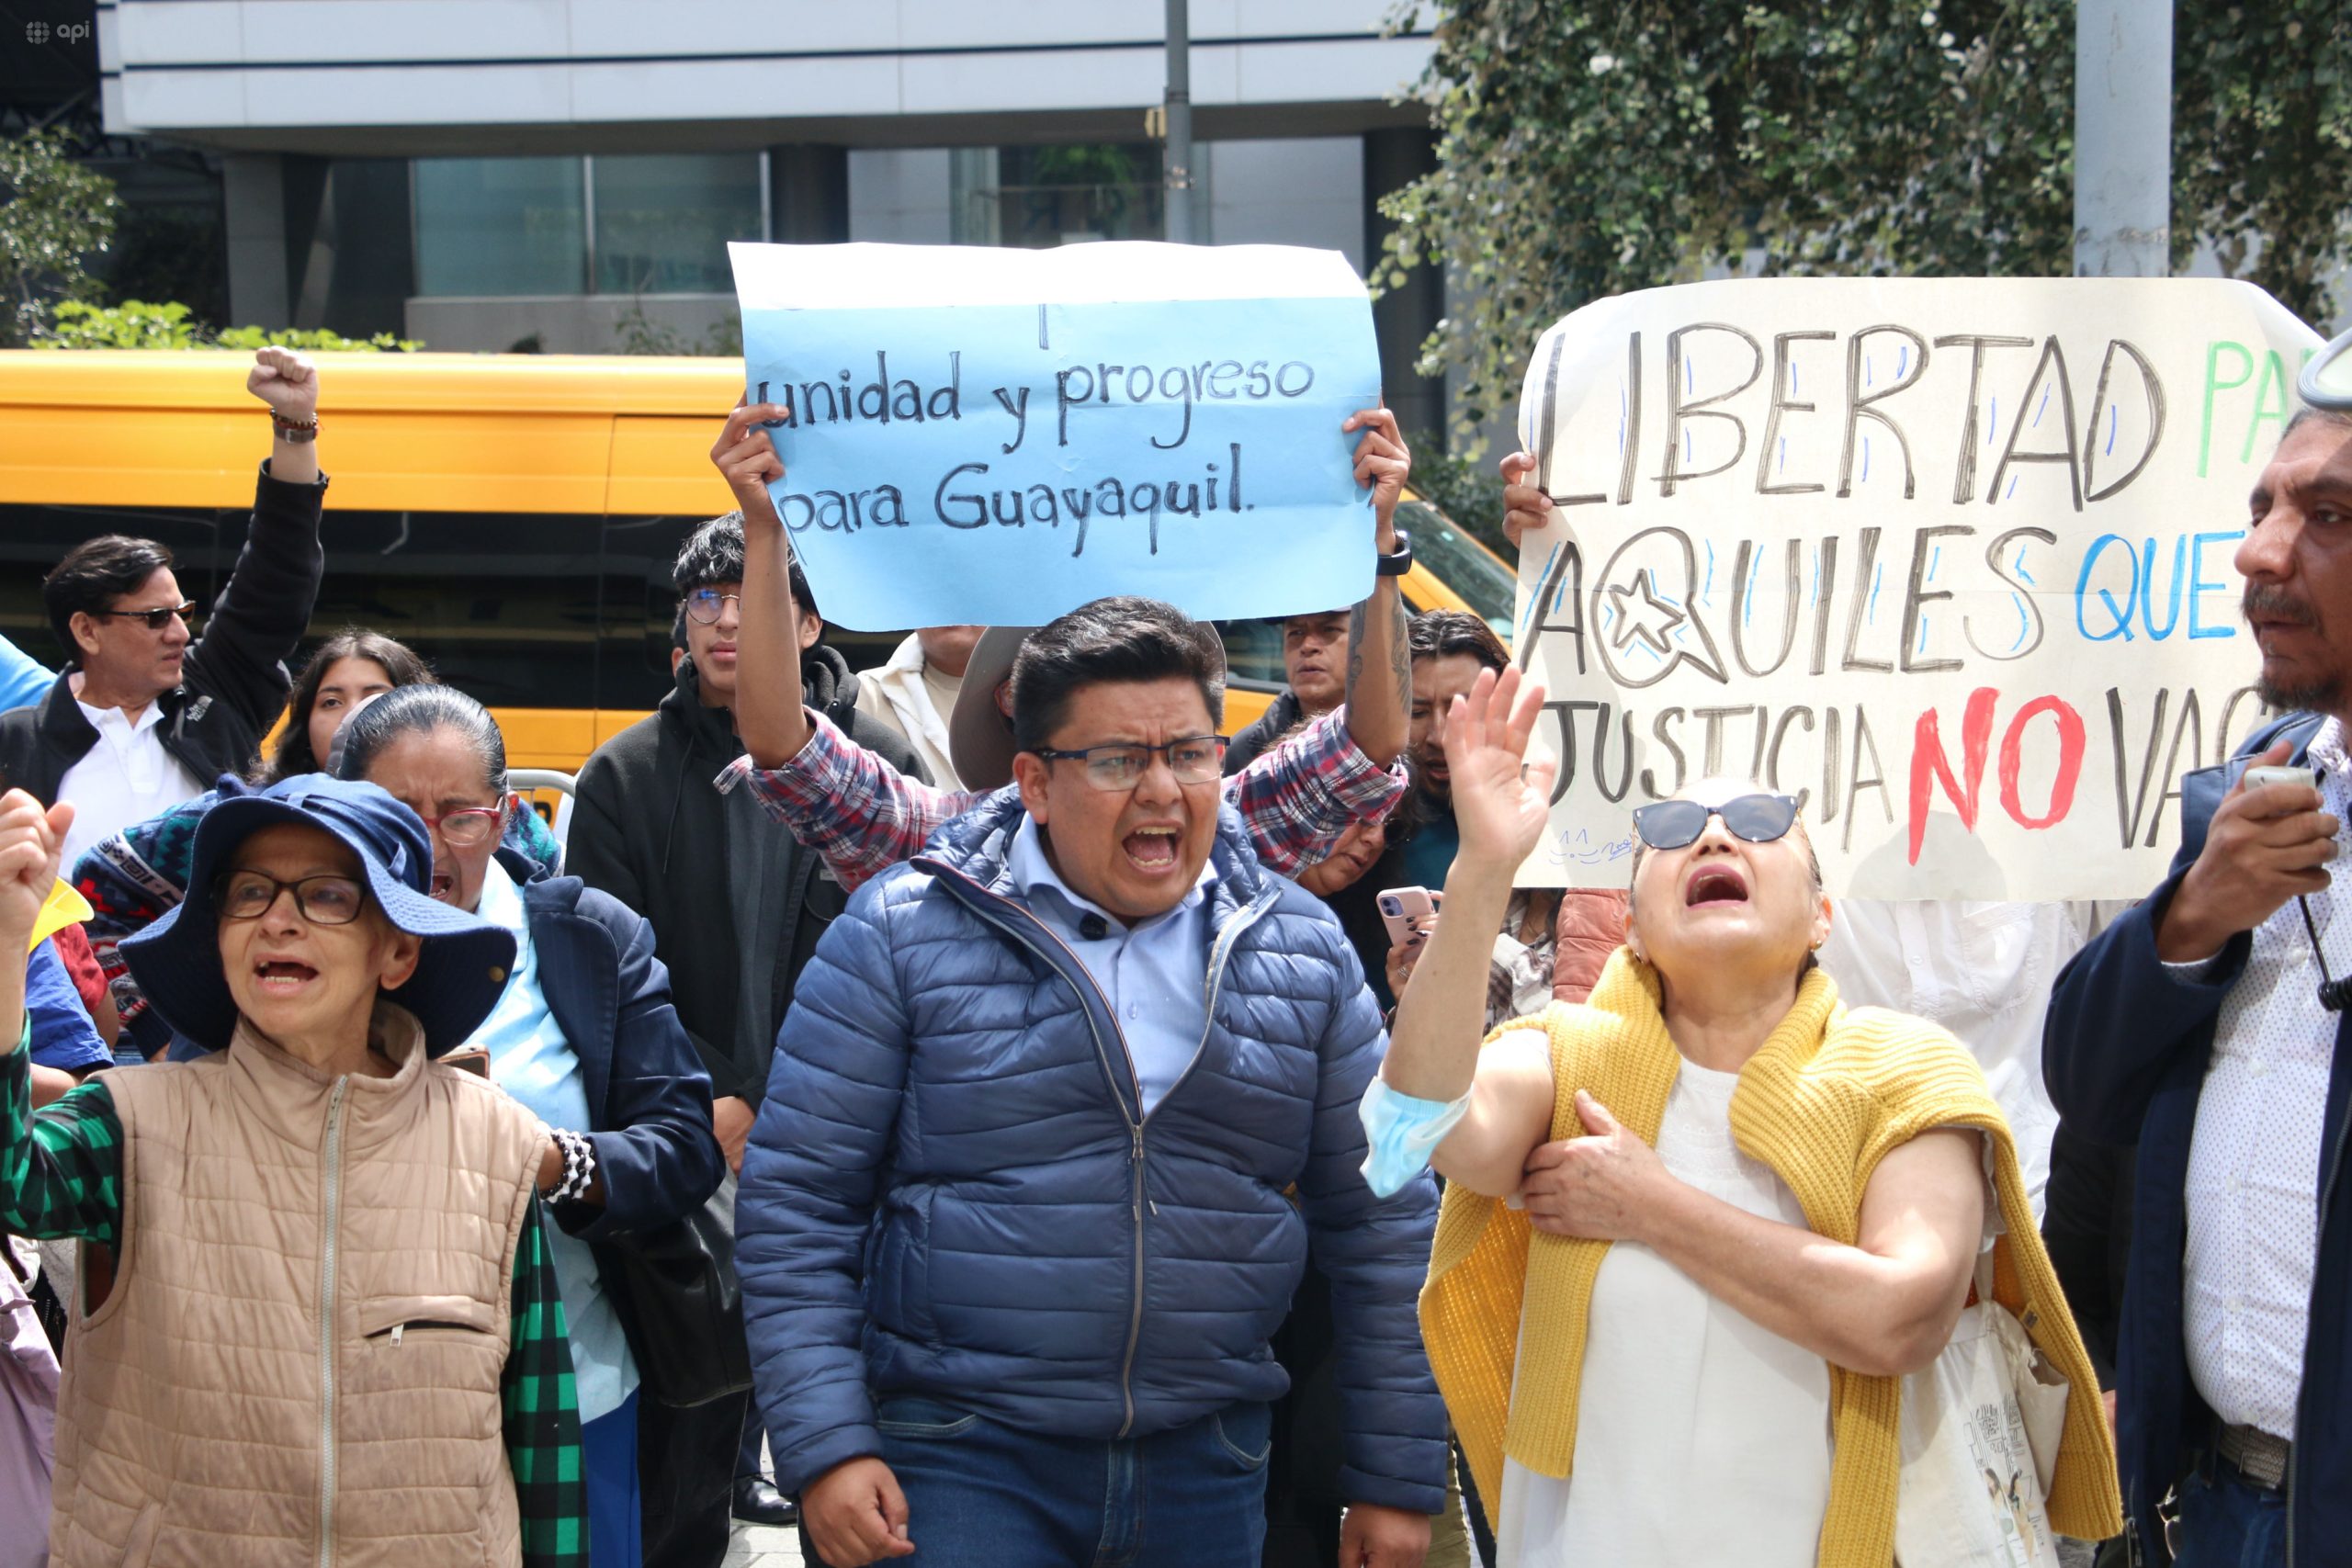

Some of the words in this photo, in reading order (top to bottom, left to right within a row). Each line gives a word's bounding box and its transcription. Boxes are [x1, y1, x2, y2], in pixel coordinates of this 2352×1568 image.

[758, 350, 962, 429] unidad
[993, 386, 1031, 454] y
[1057, 356, 1315, 449] progreso
[1538, 322, 2165, 512] LIBERTAD
[2197, 341, 2319, 478] PA
[778, 484, 910, 567] para
[934, 443, 1255, 558] Guayaquil.
[1520, 525, 2057, 689] AQUILES
[2075, 530, 2245, 641] QUE
[1521, 702, 1894, 854] JUSTICIA
[1908, 687, 2086, 866] NO
